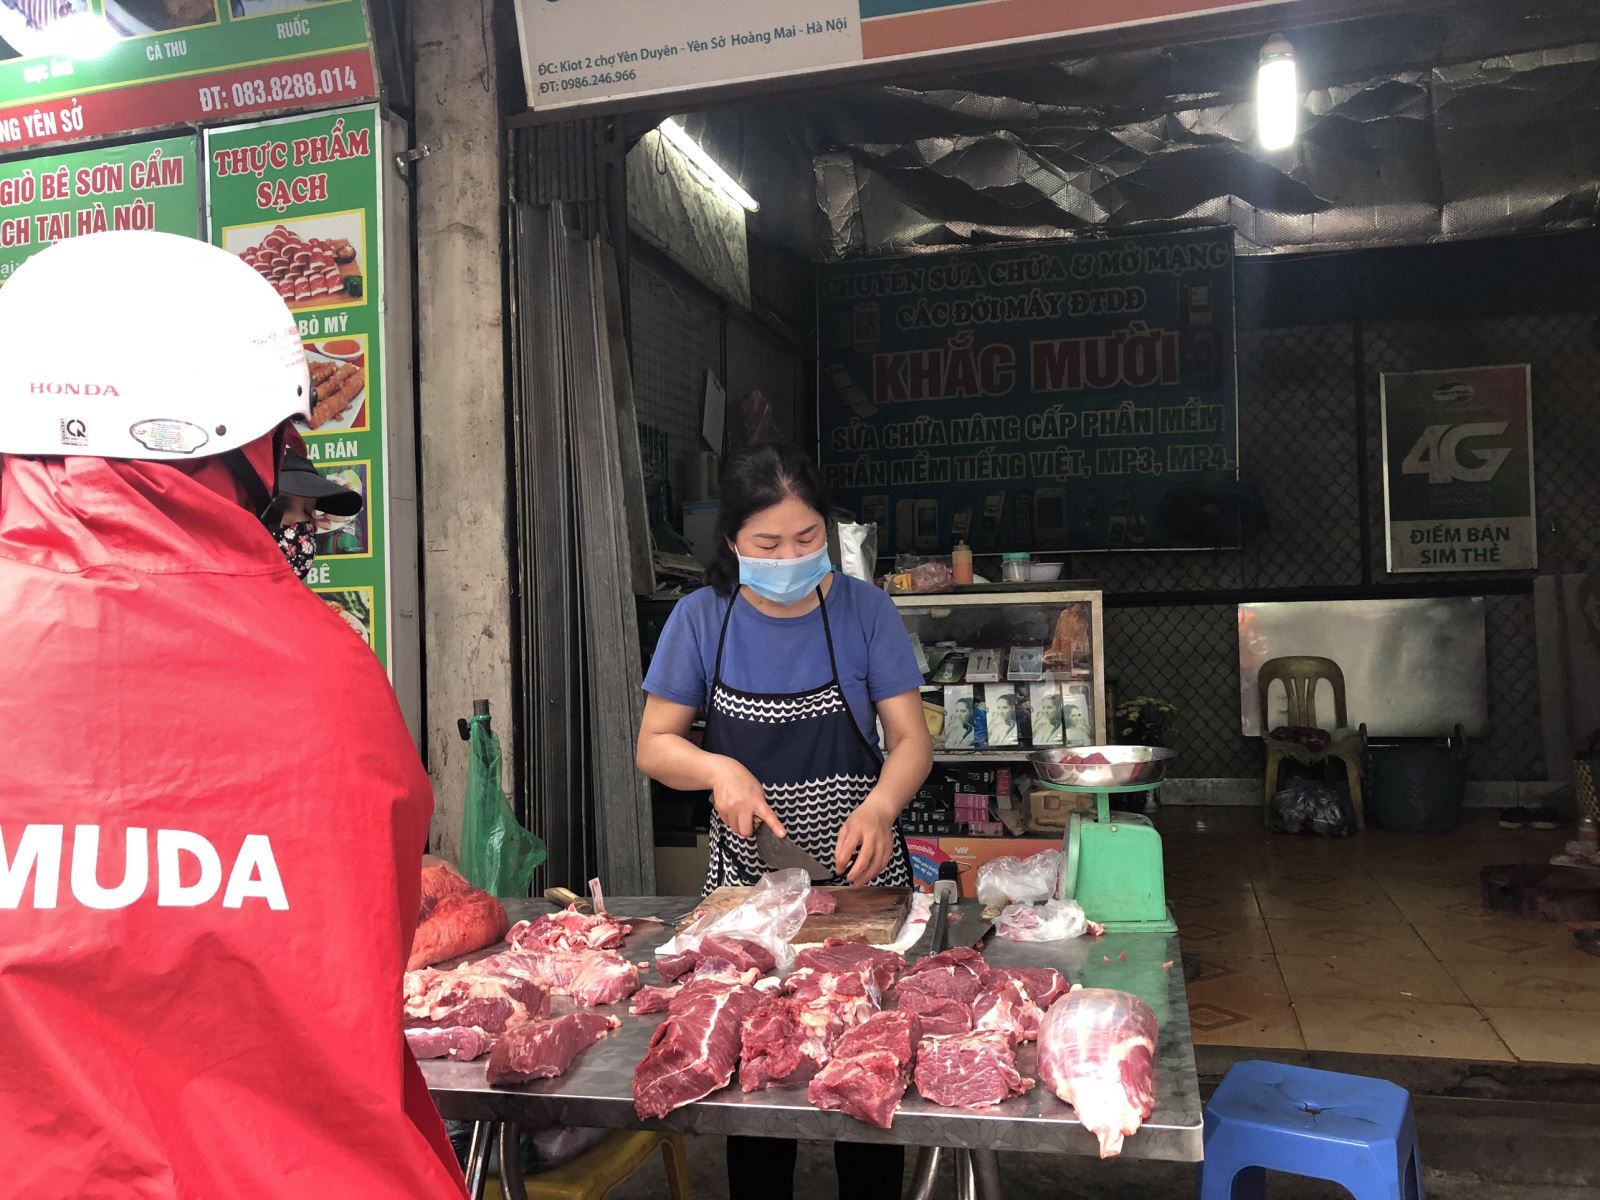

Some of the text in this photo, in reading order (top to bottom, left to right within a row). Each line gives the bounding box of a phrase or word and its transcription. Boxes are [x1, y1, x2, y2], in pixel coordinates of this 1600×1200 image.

[276, 15, 310, 39] RUỐC
[585, 57, 592, 69] 2
[594, 54, 615, 68] chợ
[617, 51, 637, 63] Yên
[640, 45, 678, 61] Duyên
[687, 40, 708, 53] Yên
[711, 35, 726, 49] Sở
[731, 31, 771, 47] Hoàng
[774, 24, 796, 40] Mai
[806, 20, 823, 34] Hà
[826, 17, 848, 33] Nội
[146, 40, 187, 61] CÁ THU
[199, 65, 357, 112] ĐT: 083.8288.014
[539, 69, 637, 94] ĐT: 0986.246.966
[22, 108, 58, 138] YÊN
[60, 97, 84, 133] SỞ
[214, 118, 370, 178] THỰC PHẨM
[0, 149, 184, 208] GIÒ BÊ SƠN CẨM
[256, 173, 328, 212] SẠCH
[0, 216, 30, 248] CH
[77, 201, 108, 236] HÀ
[823, 241, 1232, 299] CHUYÊN SỬA CHỮA & MỞ MẠNG
[298, 312, 349, 336] BÒ MỸ
[896, 298, 950, 330] CÁC
[1005, 288, 1064, 321] MÁY
[1067, 286, 1148, 317] ĐTDĐ
[873, 321, 1180, 404] KHẮC MƯỜI
[30, 382, 121, 397] HONDA
[832, 398, 1226, 452] SỬA CHỮA NÂNG CẤP PHẦN MỀM
[324, 437, 358, 459] RÁN
[824, 454, 888, 488] PHẦN
[890, 450, 950, 486] MỀM
[953, 446, 1025, 481] TIẾNG
[1401, 421, 1513, 484] 4G
[1409, 523, 1462, 545] ĐIỂM
[1420, 543, 1501, 565] SIM THẺ
[306, 563, 331, 585] BÊ
[0, 824, 290, 910] MUDA
